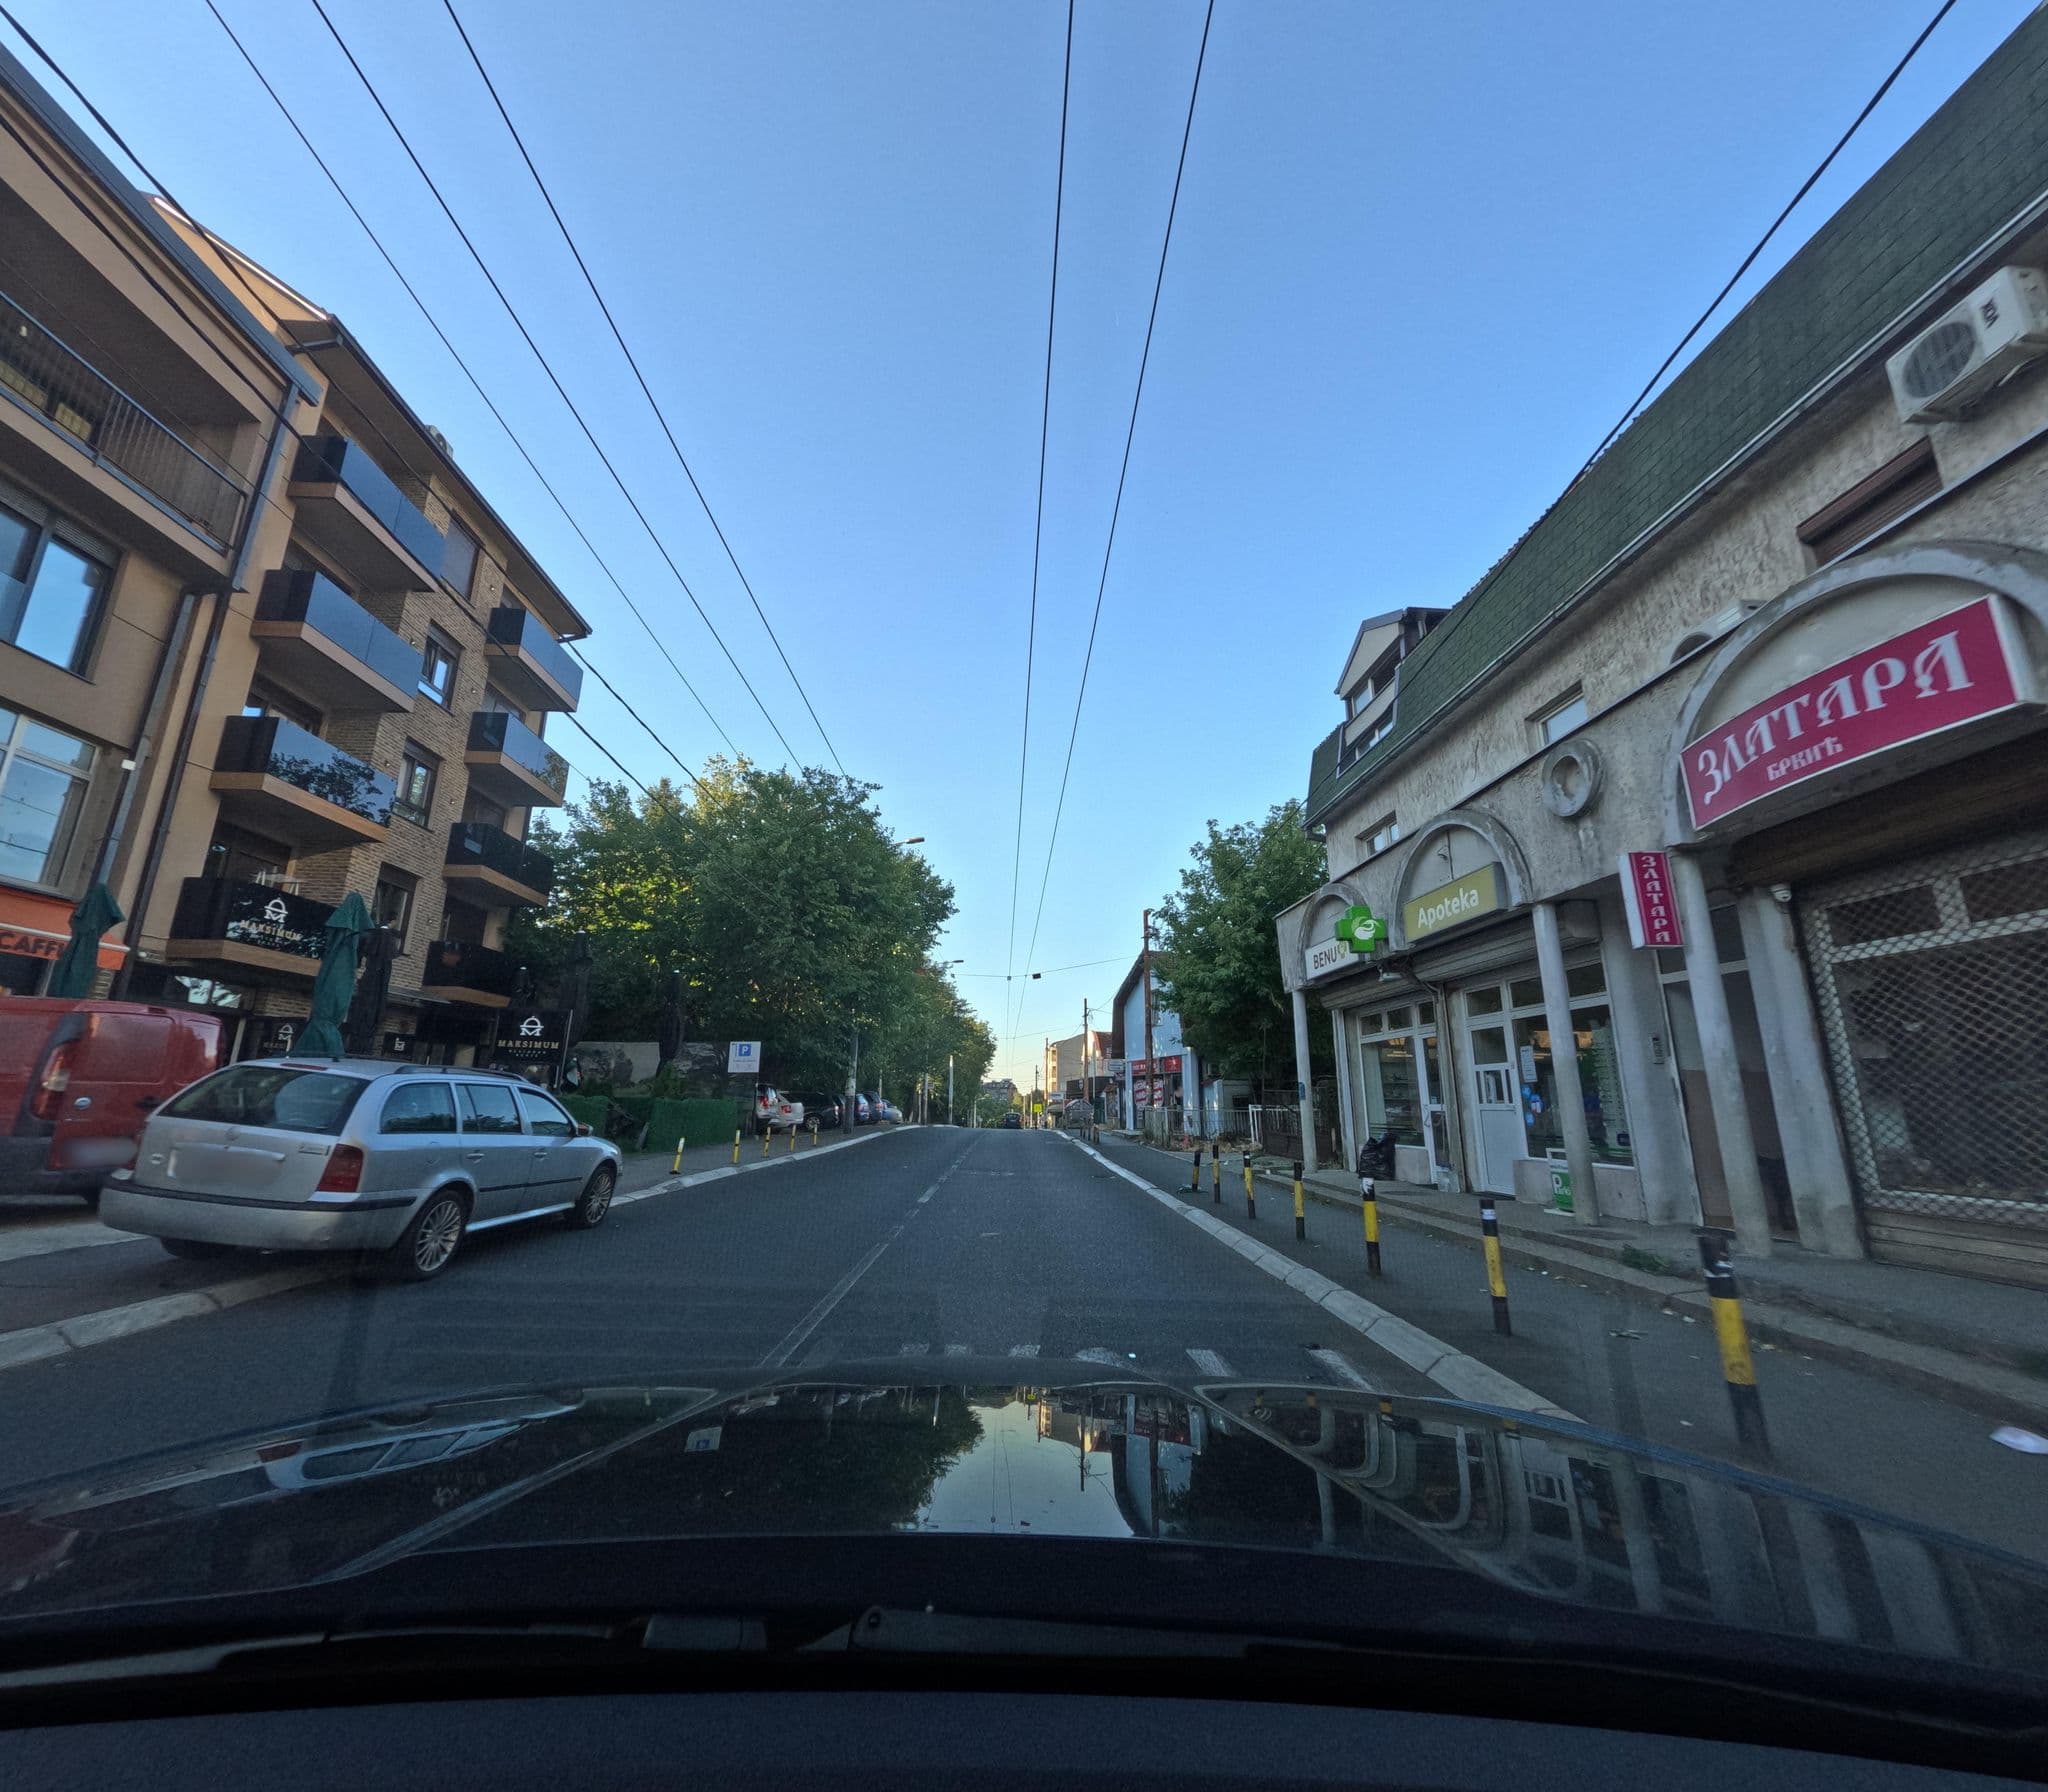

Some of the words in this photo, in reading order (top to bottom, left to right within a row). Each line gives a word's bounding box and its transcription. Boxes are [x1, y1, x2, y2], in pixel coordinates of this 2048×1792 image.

[1697, 630, 1975, 805] ЗЛАТАРА
[1766, 736, 1844, 782] БРКИЋ
[1417, 887, 1480, 929] Apoteka
[1640, 855, 1671, 943] ЗЛАТАРА
[240, 919, 303, 941] MAKSIMUM
[1312, 945, 1338, 970] BENU
[497, 1039, 560, 1049] MAKSIMUM
